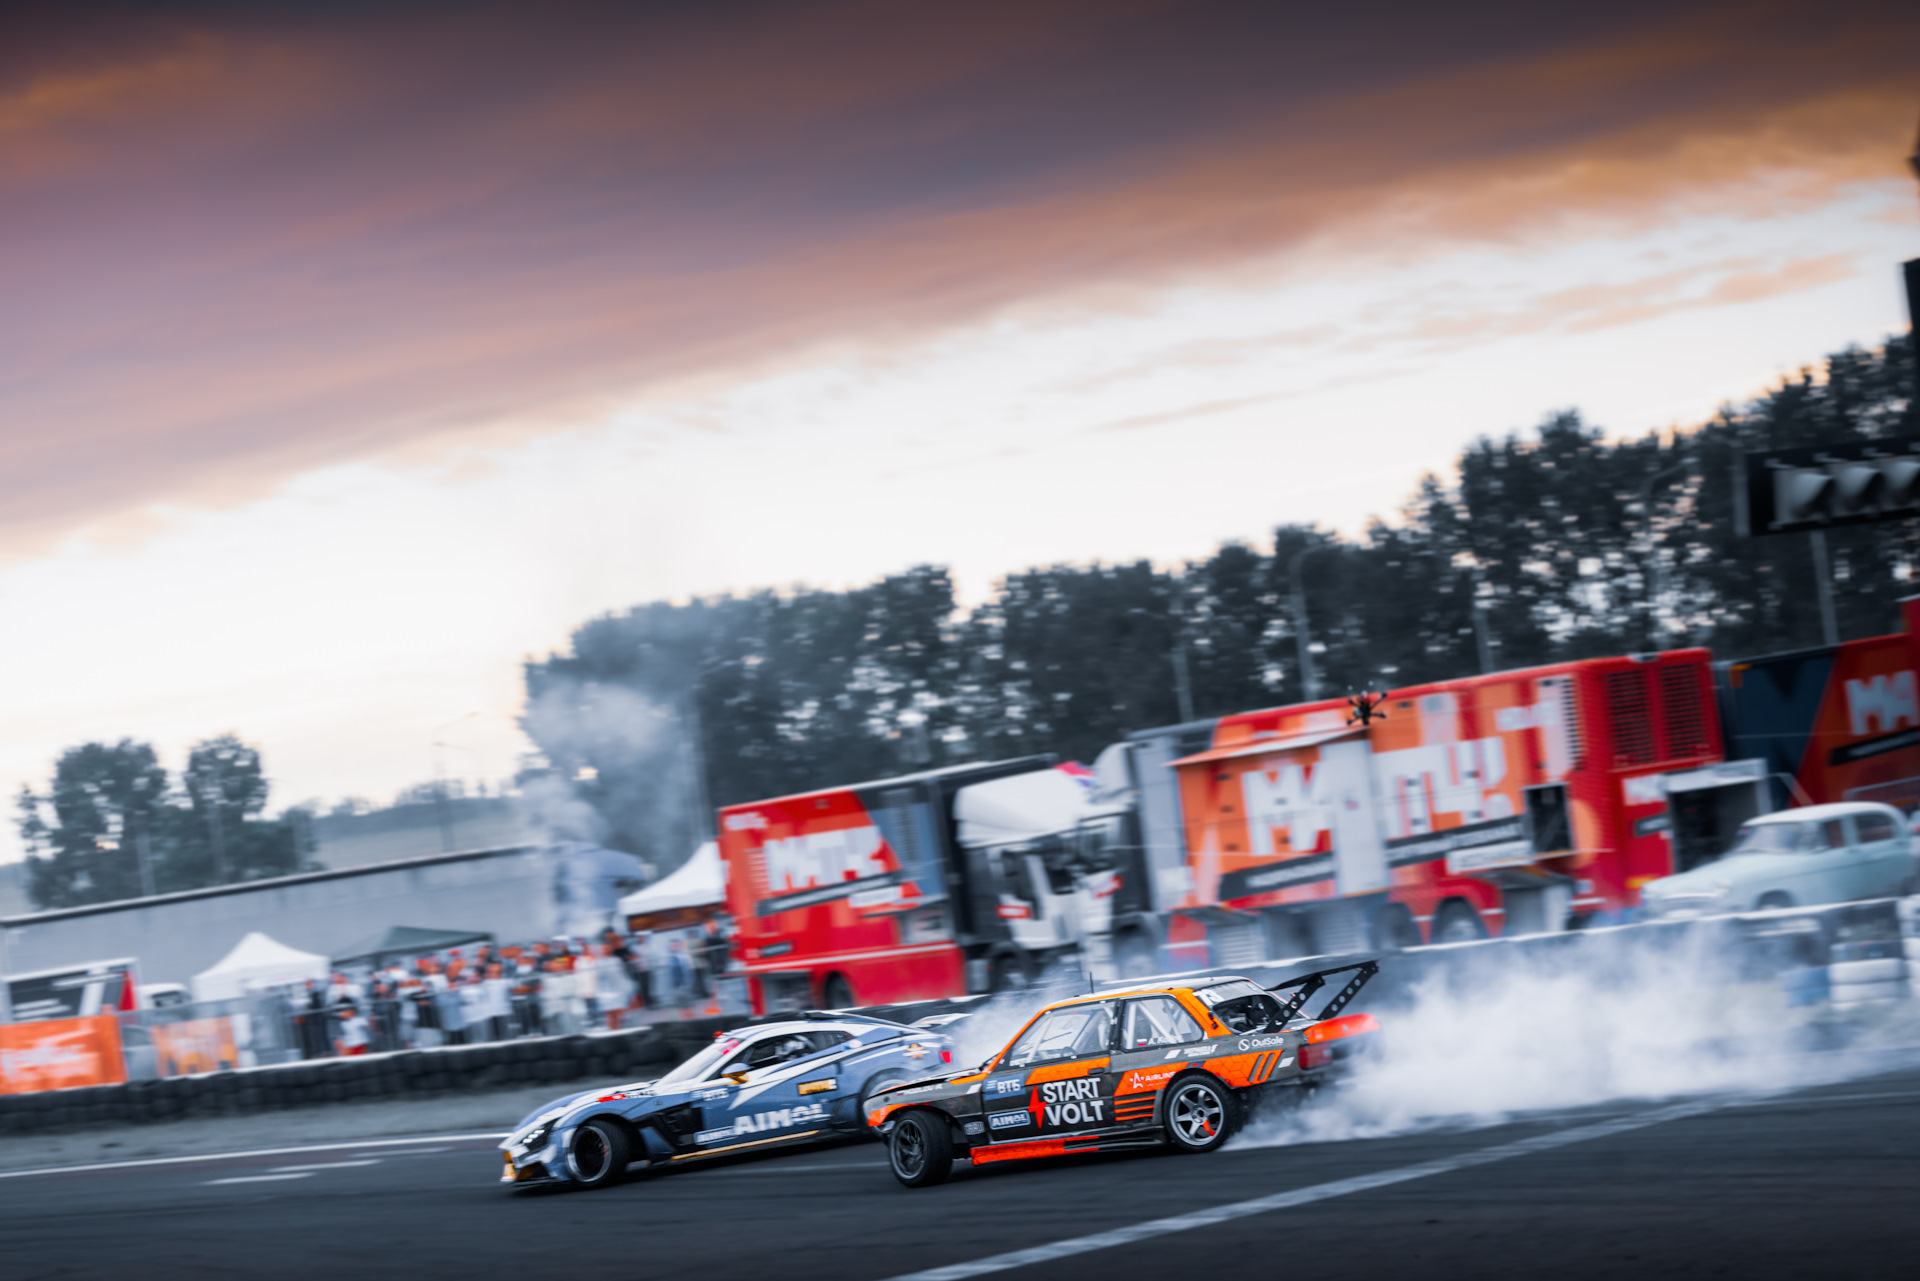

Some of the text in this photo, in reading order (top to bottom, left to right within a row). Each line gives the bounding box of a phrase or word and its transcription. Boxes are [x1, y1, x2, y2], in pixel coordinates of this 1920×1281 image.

[996, 1079, 1021, 1094] ВТБ
[1042, 1077, 1101, 1104] START
[992, 1113, 1027, 1128] AIMOL
[1044, 1100, 1104, 1126] VOLT
